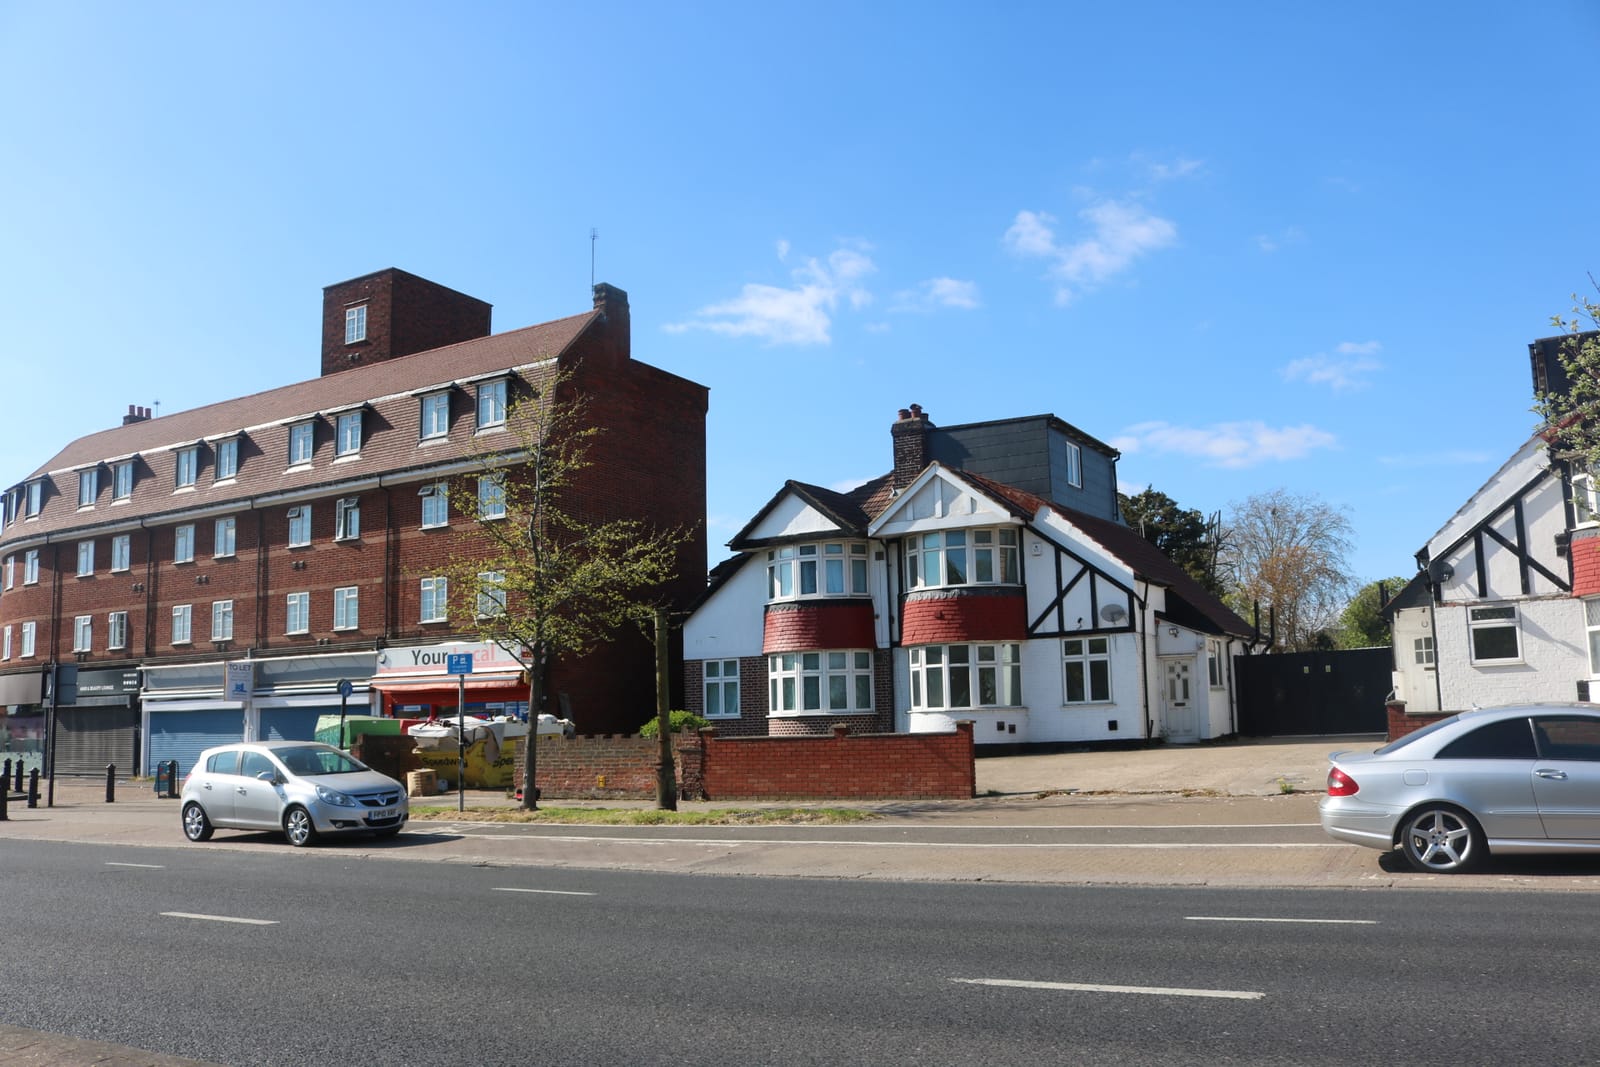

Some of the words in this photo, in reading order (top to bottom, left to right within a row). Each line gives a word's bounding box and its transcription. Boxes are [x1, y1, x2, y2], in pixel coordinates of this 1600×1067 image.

[412, 649, 448, 665] Your
[453, 643, 495, 662] cal
[452, 655, 458, 664] P
[228, 663, 238, 671] TO
